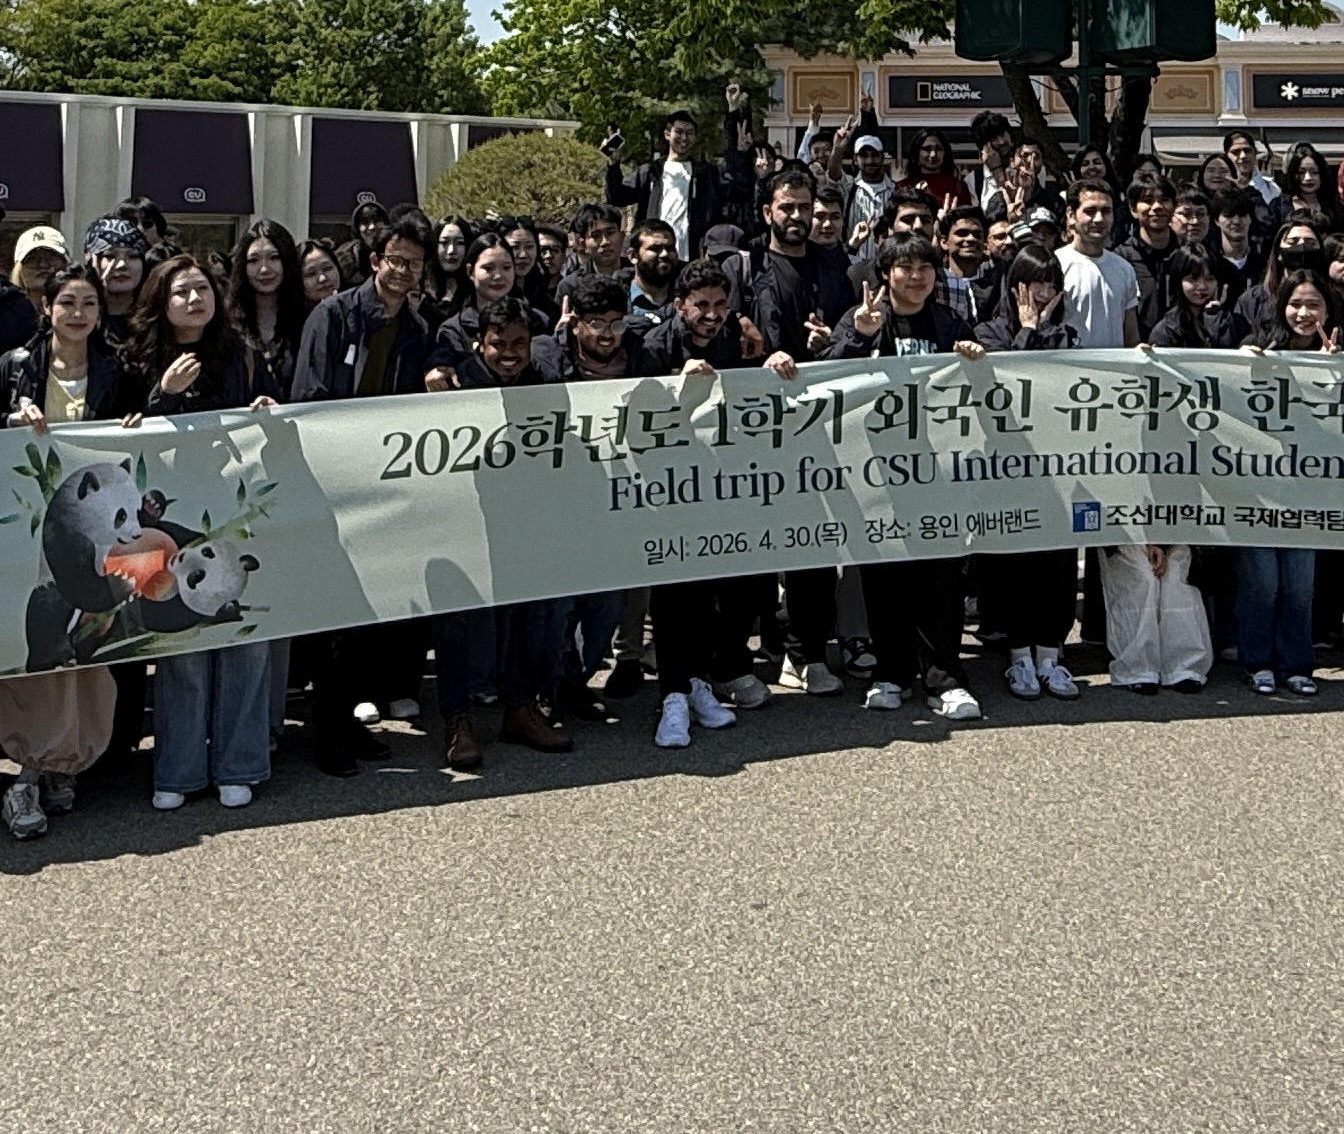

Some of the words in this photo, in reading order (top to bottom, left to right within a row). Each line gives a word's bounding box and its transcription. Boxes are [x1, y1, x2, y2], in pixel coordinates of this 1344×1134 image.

[933, 83, 971, 91] NATIONAL
[1302, 87, 1330, 96] snow
[379, 405, 690, 480] 2026학년도
[710, 389, 844, 449] 1학기
[866, 378, 1034, 440] 외국인
[1053, 375, 1221, 432] 유학생
[609, 464, 703, 511] Field
[712, 462, 785, 506] trip
[796, 456, 852, 494] for
[863, 451, 939, 487] CSU
[950, 441, 1200, 482] International
[1106, 504, 1226, 527] 조선대학교
[644, 535, 690, 565] 일시:
[697, 532, 752, 557] 2026.
[759, 529, 777, 551] 4.
[784, 521, 848, 548] 30.(목)
[865, 518, 911, 543] 장소:
[918, 513, 959, 540] 용인
[965, 509, 1042, 537] 에버랜드
